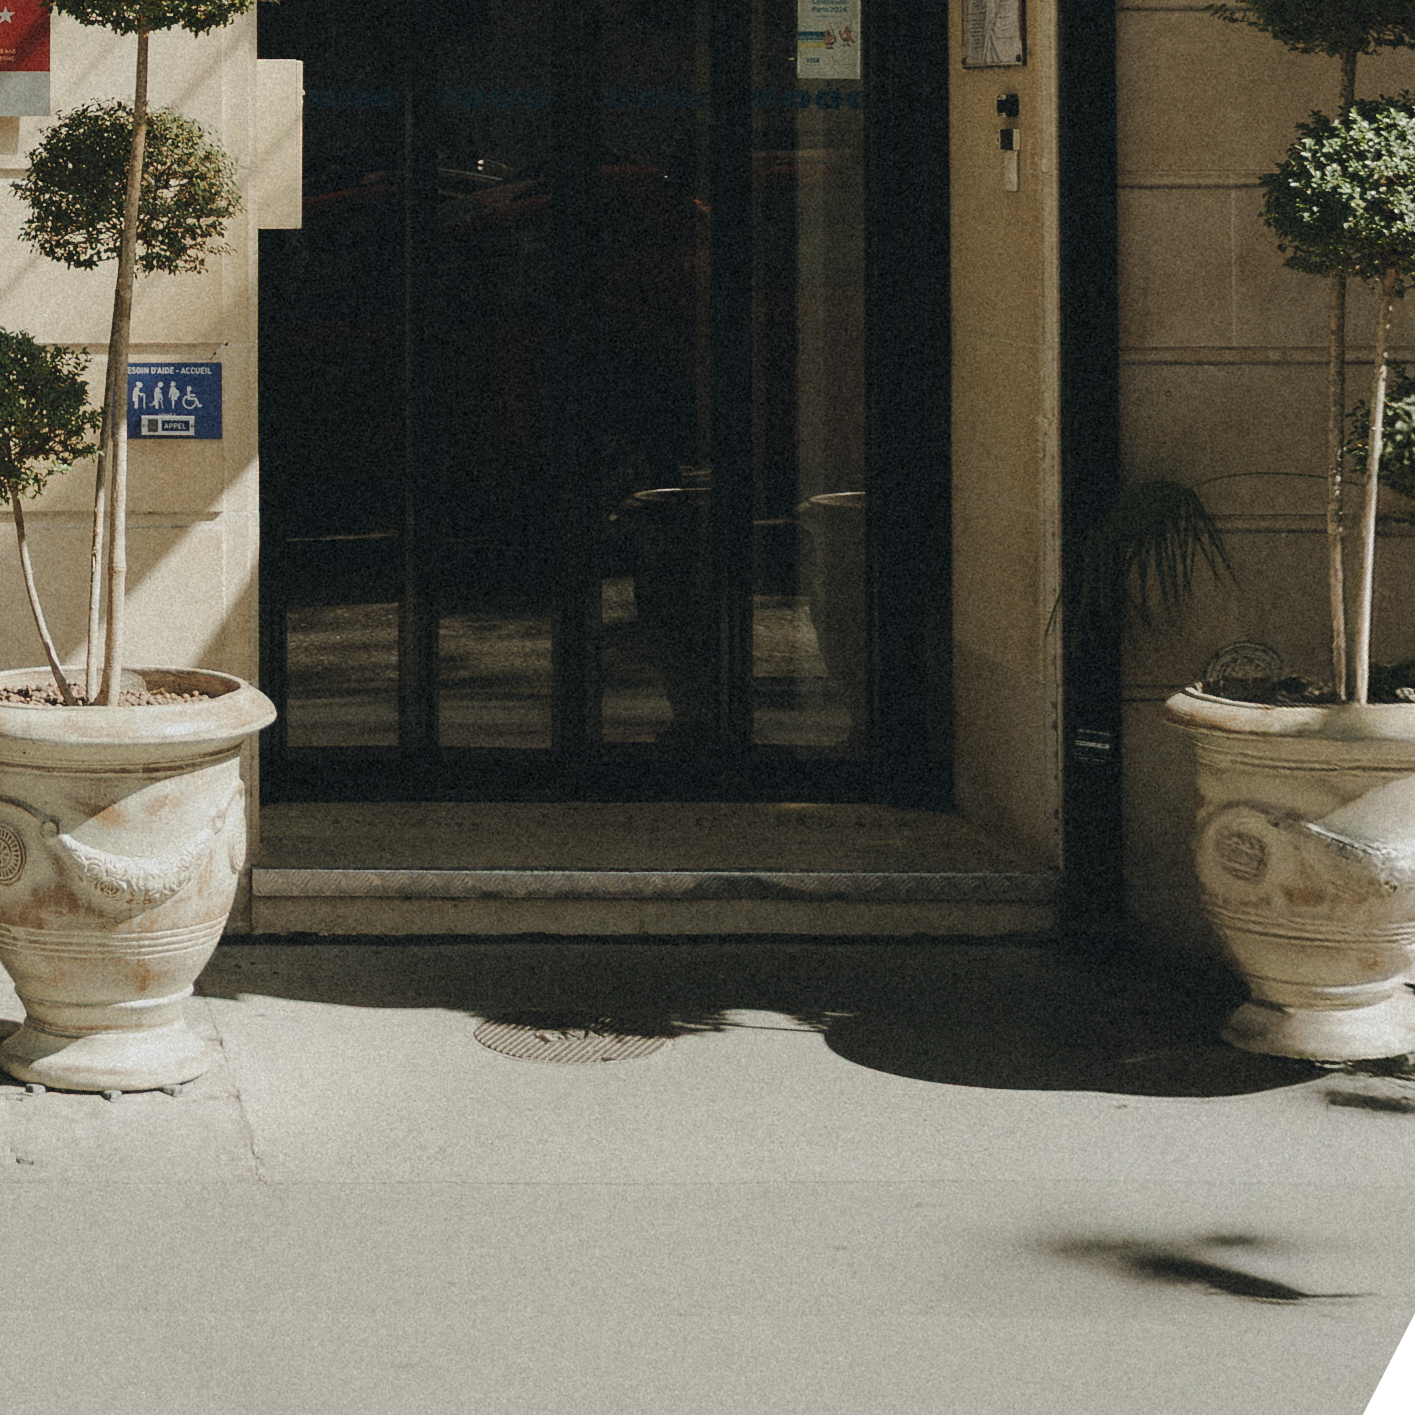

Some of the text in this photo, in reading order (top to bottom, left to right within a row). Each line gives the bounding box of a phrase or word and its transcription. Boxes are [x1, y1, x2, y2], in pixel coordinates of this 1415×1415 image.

[126, 366, 149, 375] ESOIN
[150, 366, 175, 375] D'AIDE
[180, 366, 213, 375] ACCUEIL
[164, 422, 187, 430] APPEL
